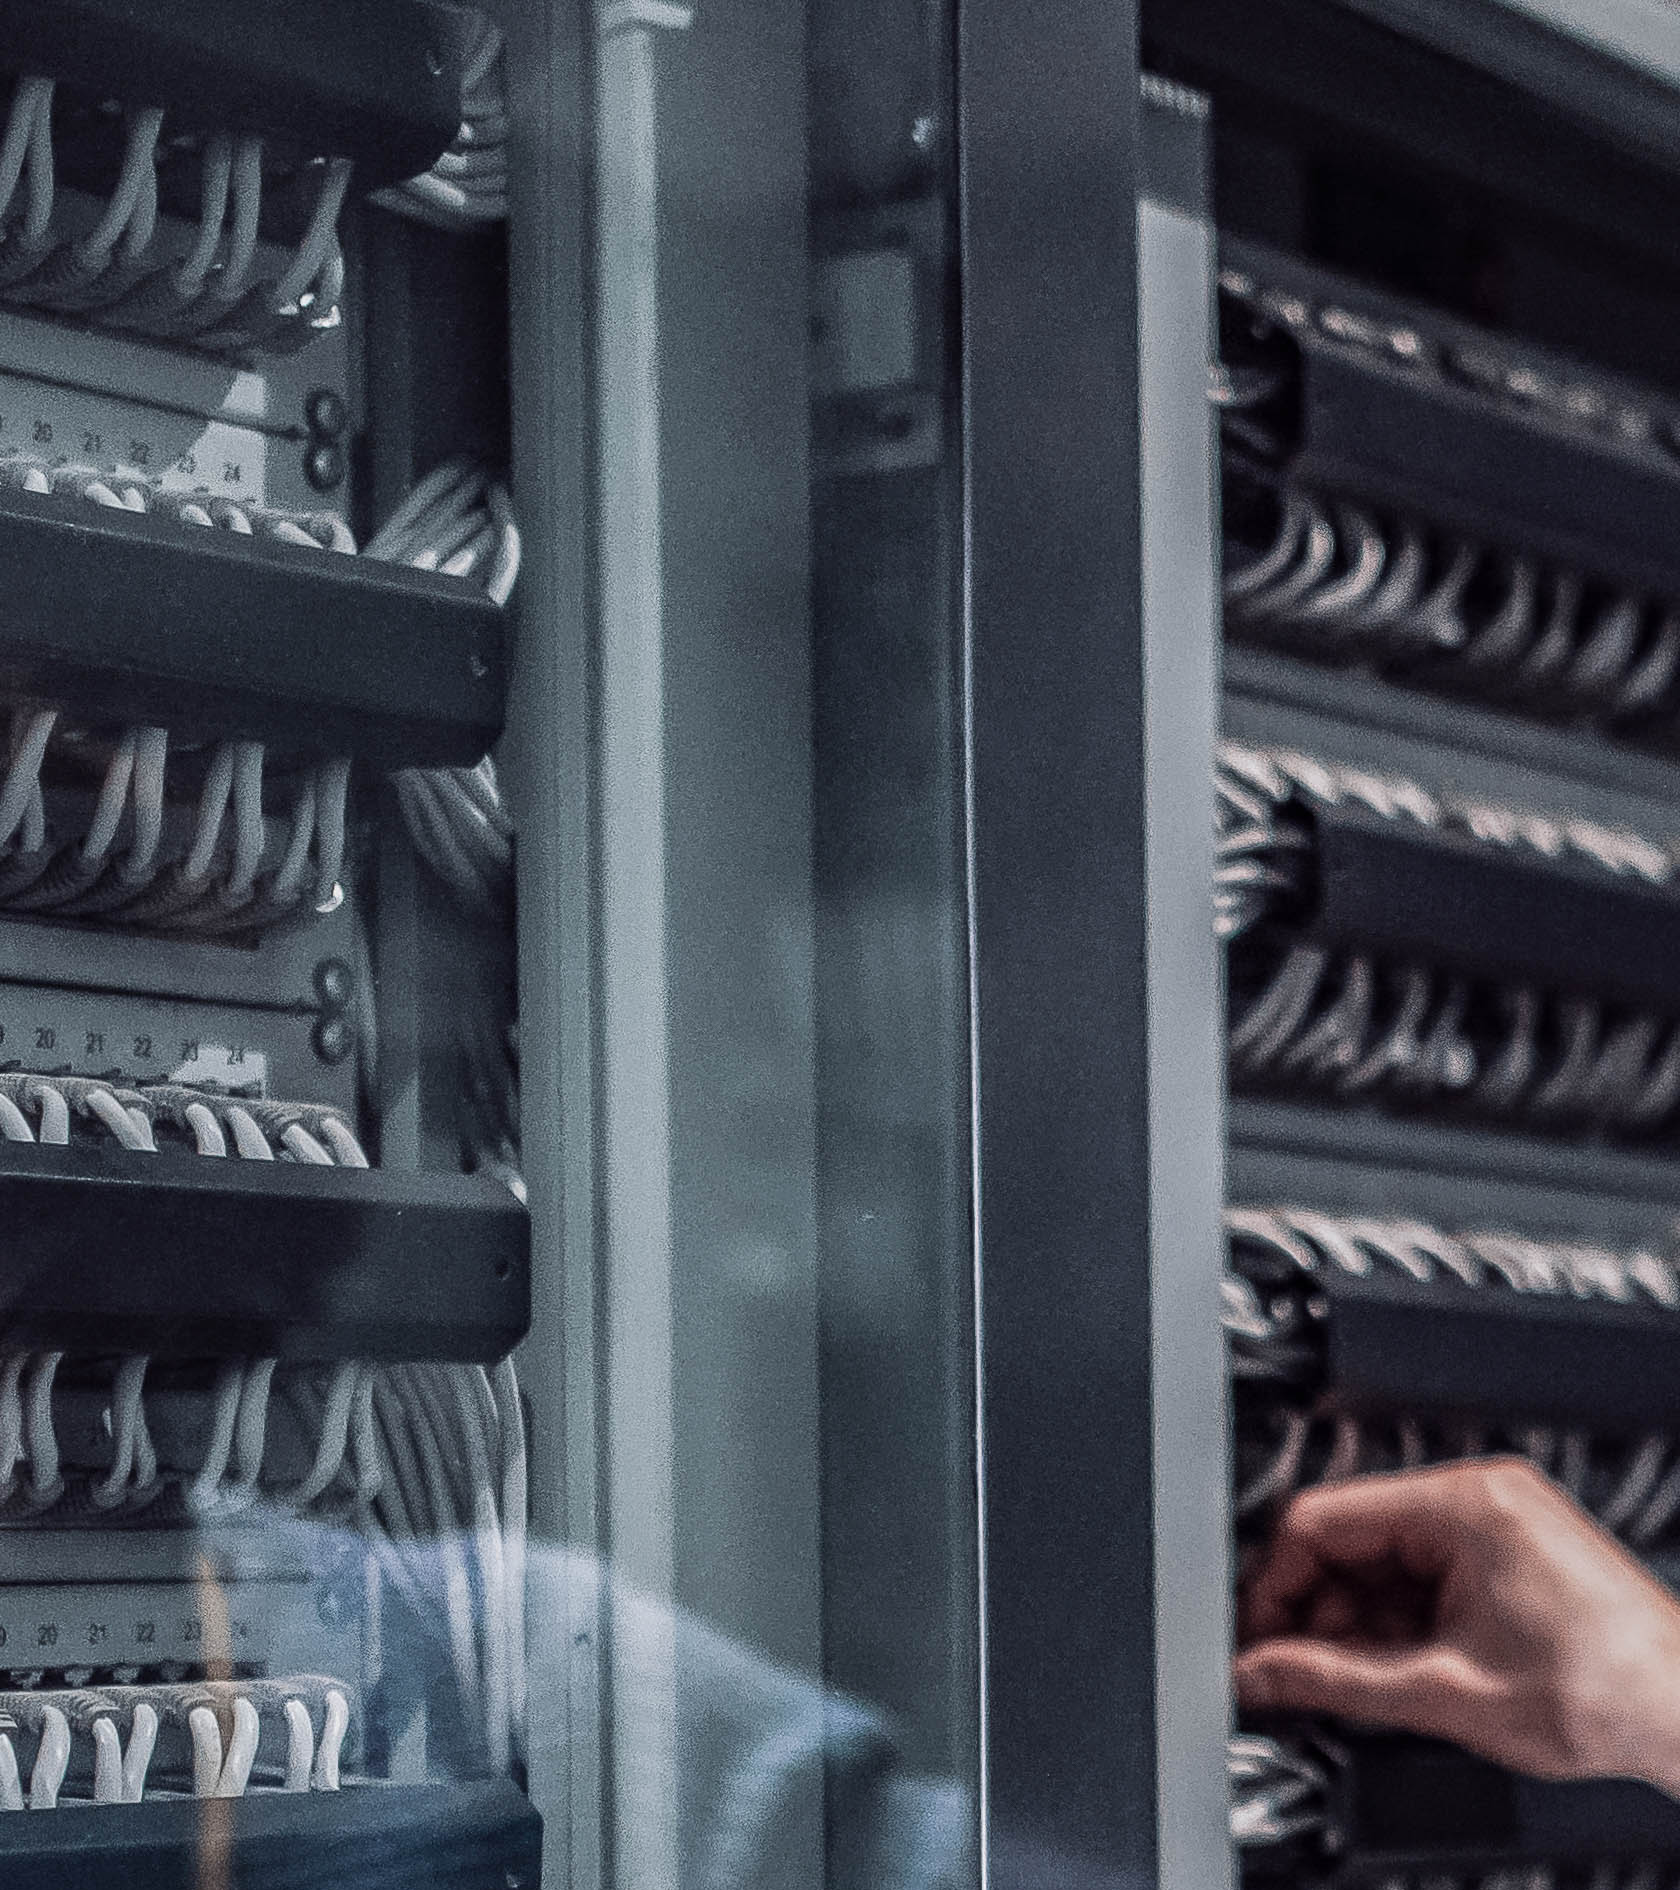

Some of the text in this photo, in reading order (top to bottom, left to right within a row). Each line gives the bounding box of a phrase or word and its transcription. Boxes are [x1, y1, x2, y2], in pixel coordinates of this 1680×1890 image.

[32, 420, 53, 444] 20
[82, 431, 102, 454] 21
[35, 1027, 55, 1049] 20
[86, 1032, 104, 1054] 21
[134, 1036, 152, 1059] 22
[37, 1624, 58, 1646] 20
[136, 1621, 155, 1643] 22
